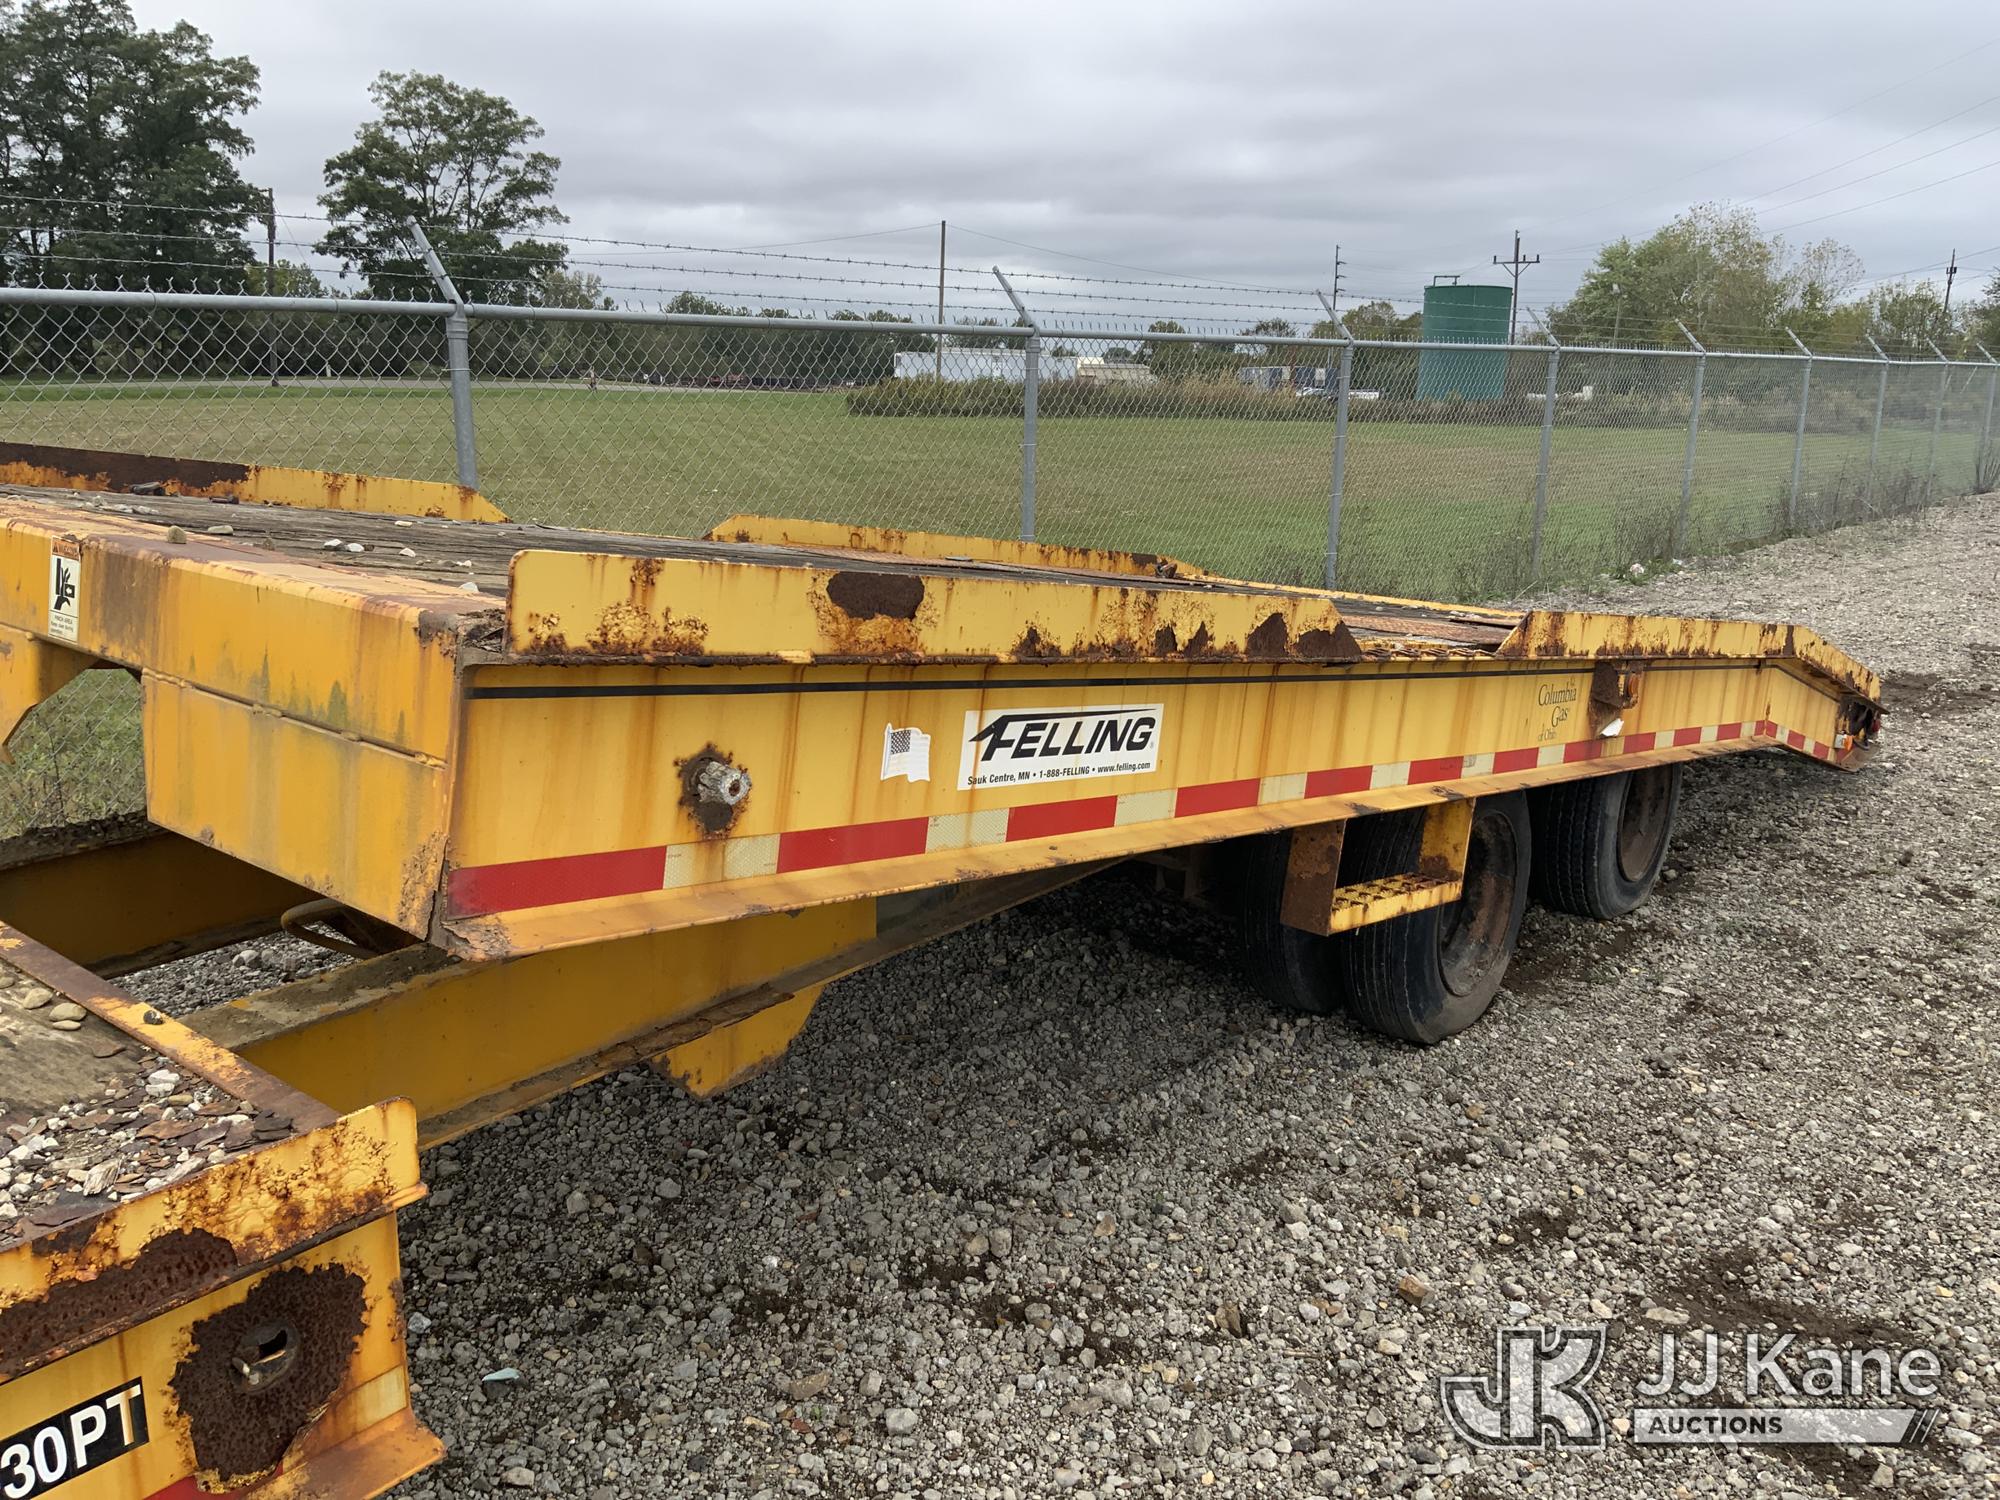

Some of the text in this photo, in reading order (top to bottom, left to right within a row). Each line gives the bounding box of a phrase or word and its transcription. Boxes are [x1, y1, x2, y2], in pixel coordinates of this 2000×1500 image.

[1538, 681, 1577, 706] Columbia
[1551, 706, 1568, 728] Gas
[969, 708, 1156, 762] FELLING
[967, 762, 1151, 786] Sauk Centre, MN 1-888-FELLING www.felling.com
[0, 1384, 141, 1499] 30PT
